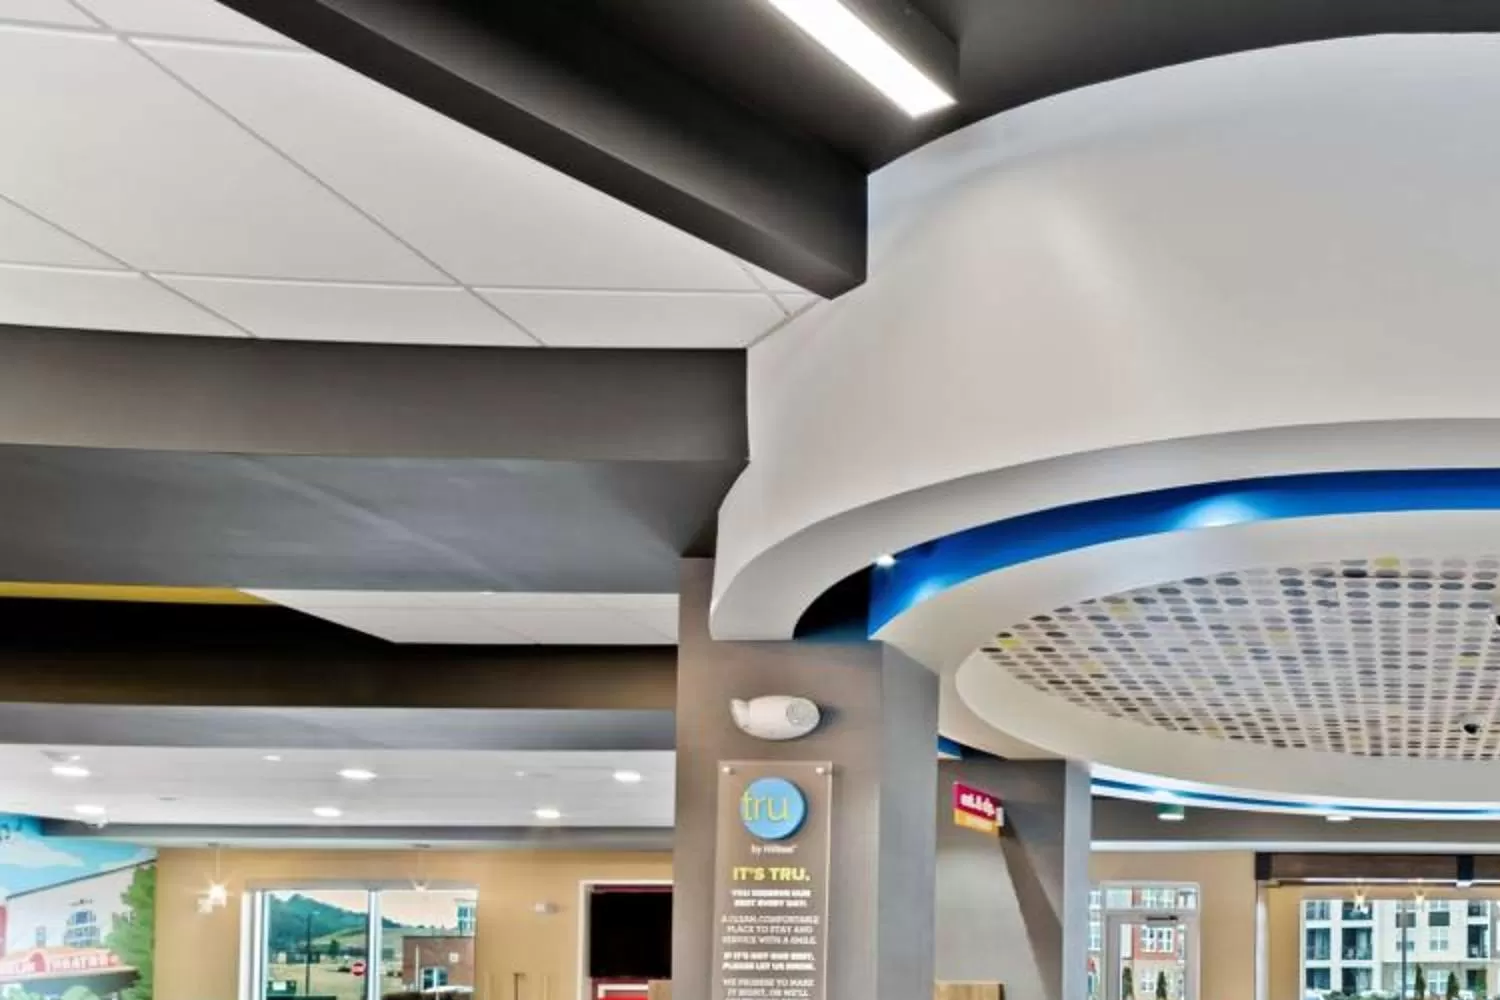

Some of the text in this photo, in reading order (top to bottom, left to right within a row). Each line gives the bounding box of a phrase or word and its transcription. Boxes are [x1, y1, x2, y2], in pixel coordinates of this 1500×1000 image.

[741, 791, 788, 821] tru
[733, 866, 811, 881] IT'S TRU.
